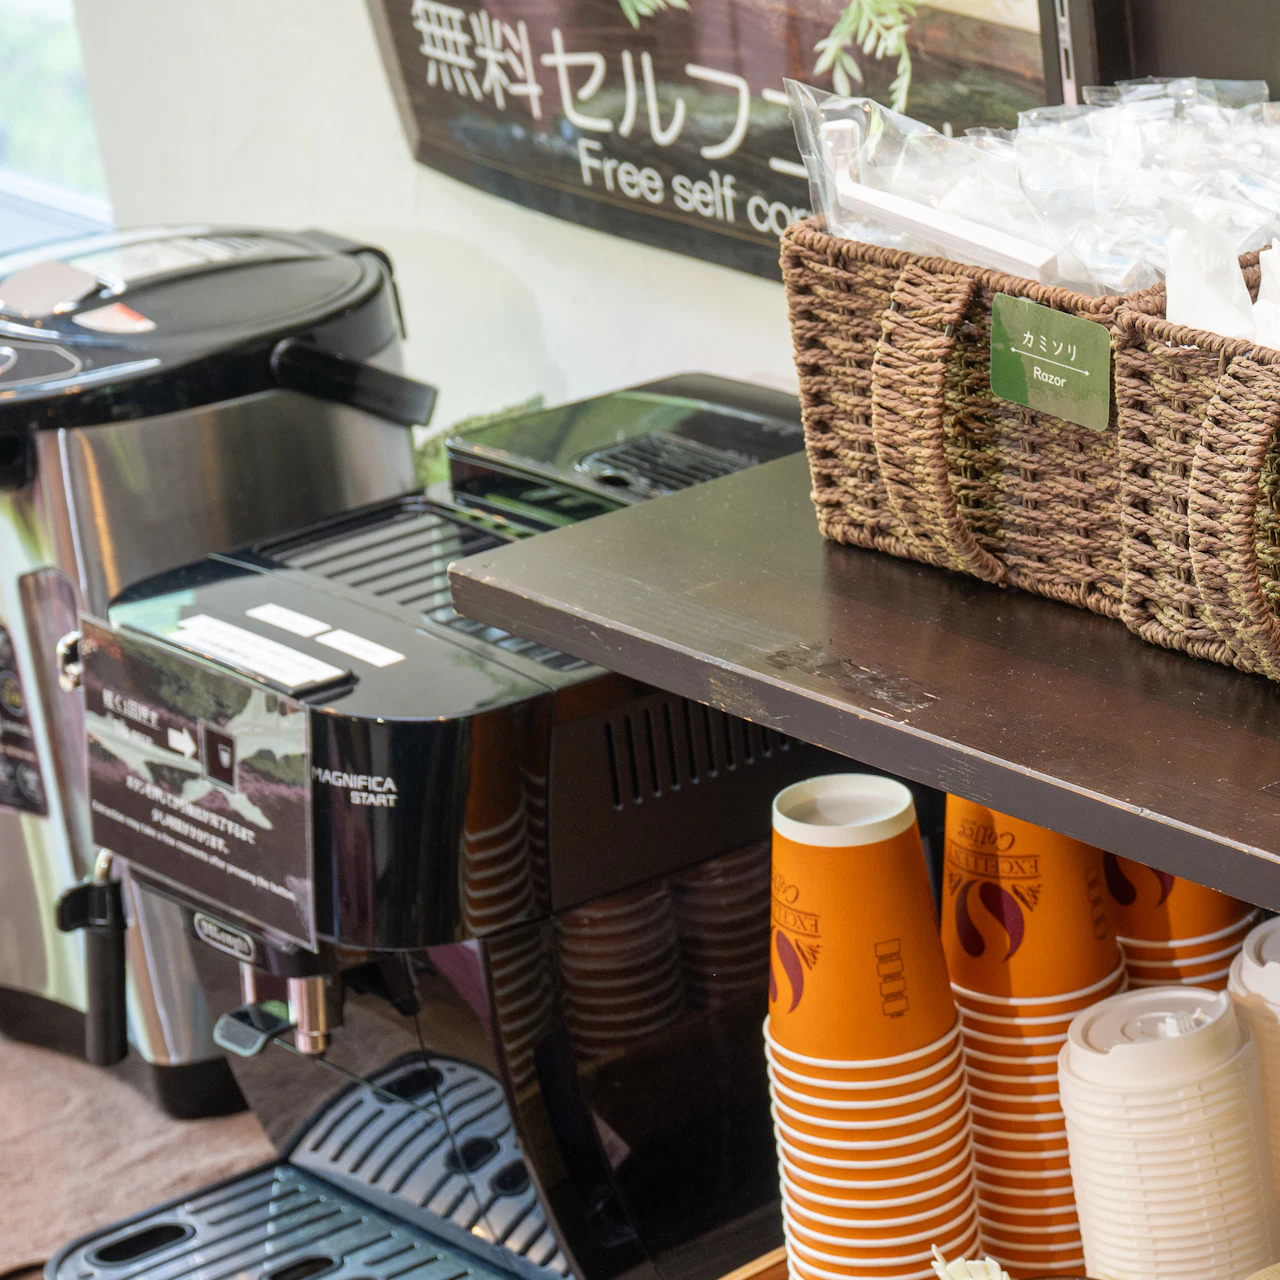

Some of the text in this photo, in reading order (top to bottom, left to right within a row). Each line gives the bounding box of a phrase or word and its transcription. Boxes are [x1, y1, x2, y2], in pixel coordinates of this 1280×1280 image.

[578, 139, 663, 202] Free
[671, 168, 737, 224] self
[1022, 329, 1079, 362] カミソリ
[1033, 365, 1066, 388] Razor
[311, 766, 398, 793] MAGNIFICA
[350, 791, 398, 807] START
